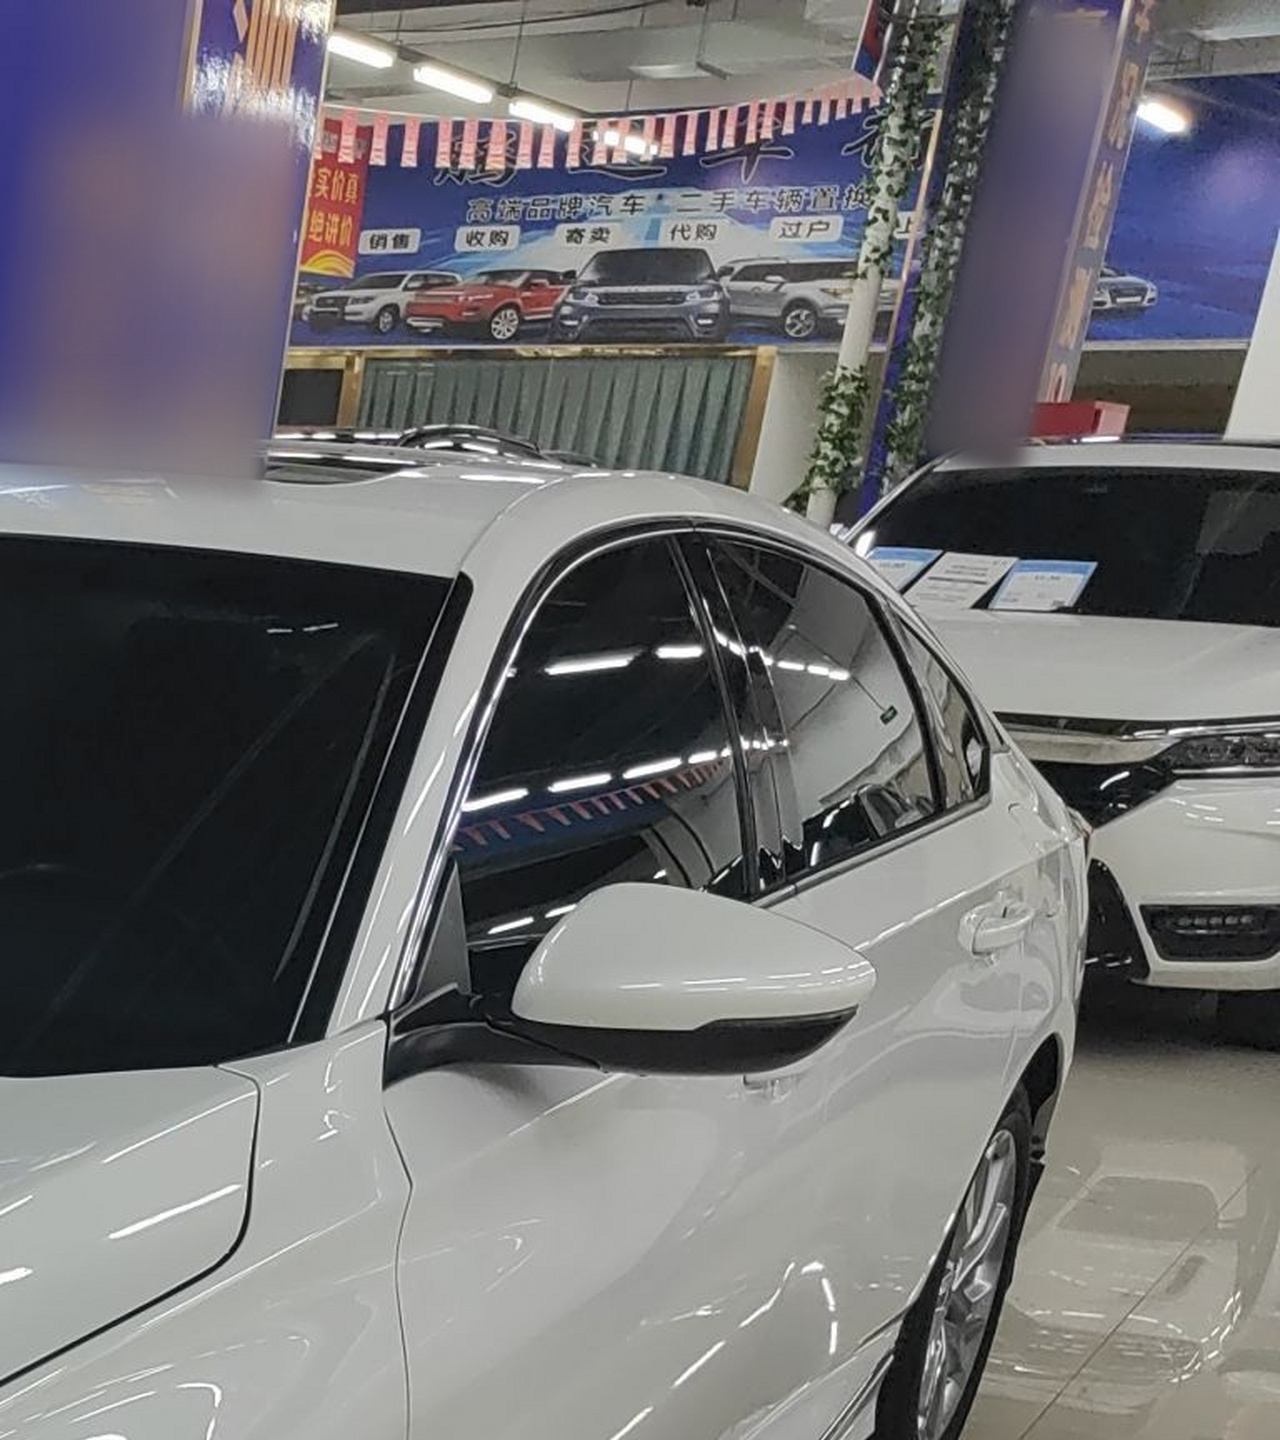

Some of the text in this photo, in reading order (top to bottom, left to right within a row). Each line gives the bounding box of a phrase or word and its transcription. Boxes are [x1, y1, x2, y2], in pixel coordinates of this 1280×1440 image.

[465, 229, 510, 248] 收购
[565, 225, 611, 244] 寄卖
[669, 221, 718, 241] 代购
[778, 219, 832, 239] 过户
[369, 233, 411, 250] 销售
